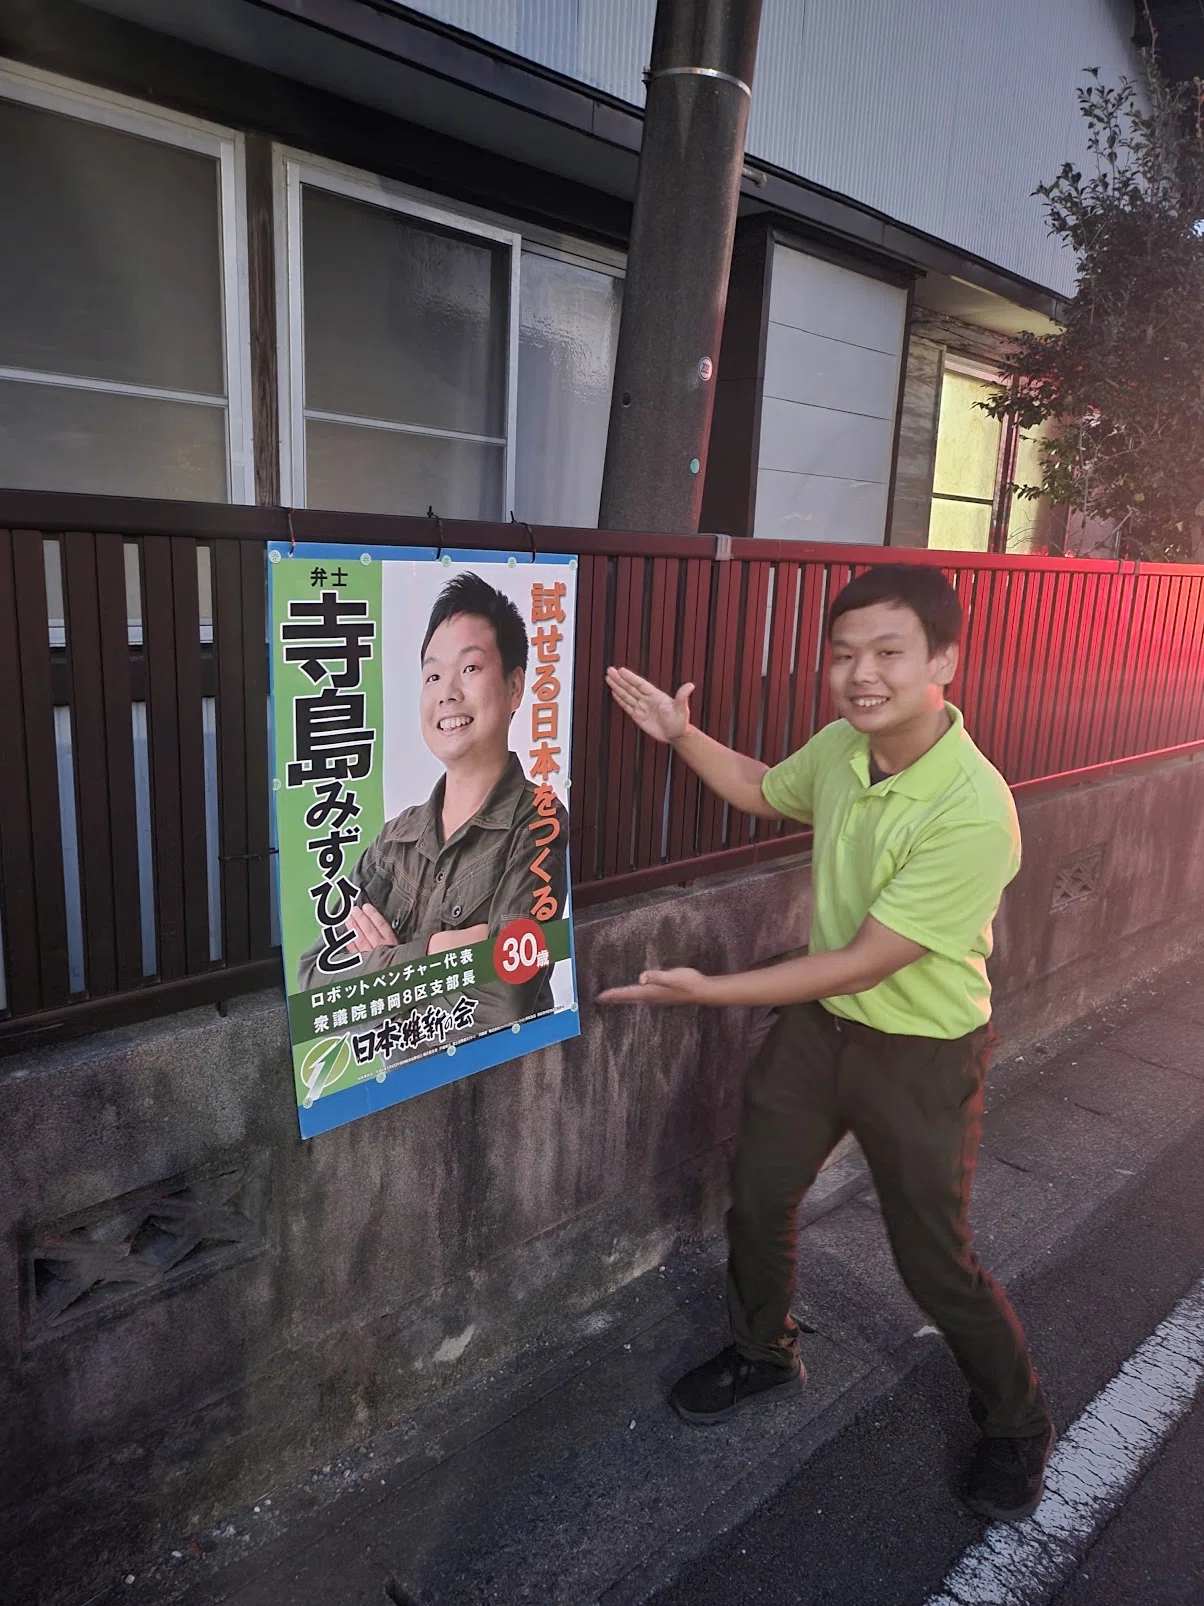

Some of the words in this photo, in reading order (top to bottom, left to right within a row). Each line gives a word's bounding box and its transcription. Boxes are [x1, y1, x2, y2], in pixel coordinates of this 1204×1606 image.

[310, 566, 348, 587] 弁士
[280, 590, 376, 974] 寺島みずひと
[528, 581, 567, 921] 試せる日本をつくる
[311, 948, 474, 1009] ロボットベンチャー代表
[313, 969, 476, 1034] 衆議院静岡8区支部長
[352, 995, 479, 1066] 日本維新の会
